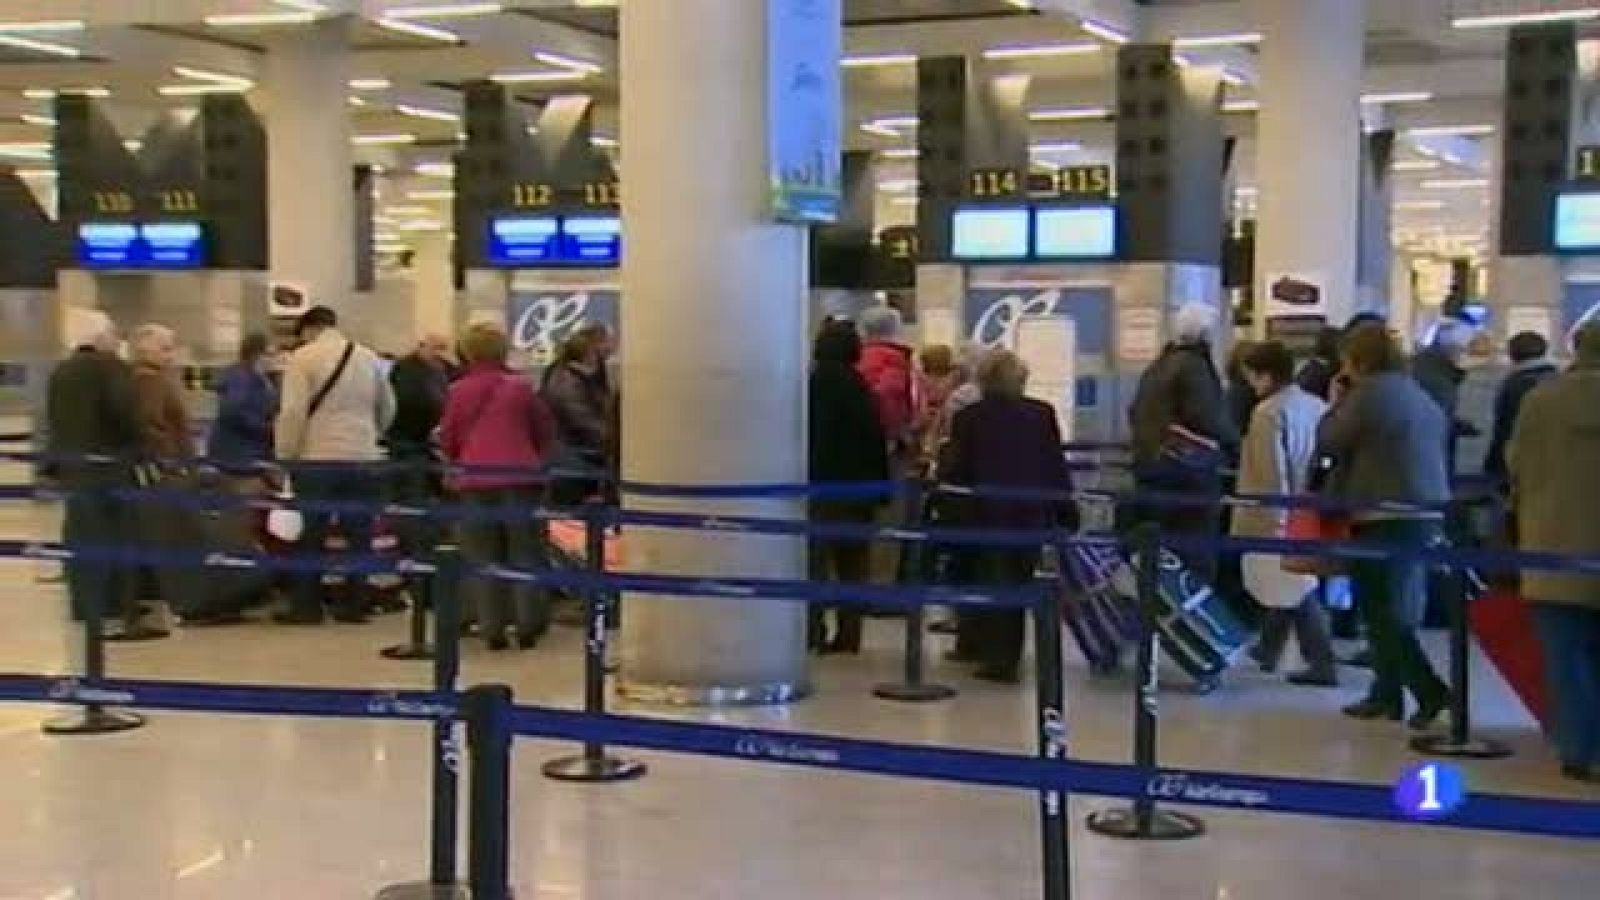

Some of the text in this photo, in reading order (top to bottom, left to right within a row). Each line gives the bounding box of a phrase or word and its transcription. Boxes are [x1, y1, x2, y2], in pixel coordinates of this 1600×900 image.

[972, 171, 1017, 196] 114
[1061, 167, 1108, 193] 115
[160, 189, 198, 212] 111
[512, 183, 552, 207] 112
